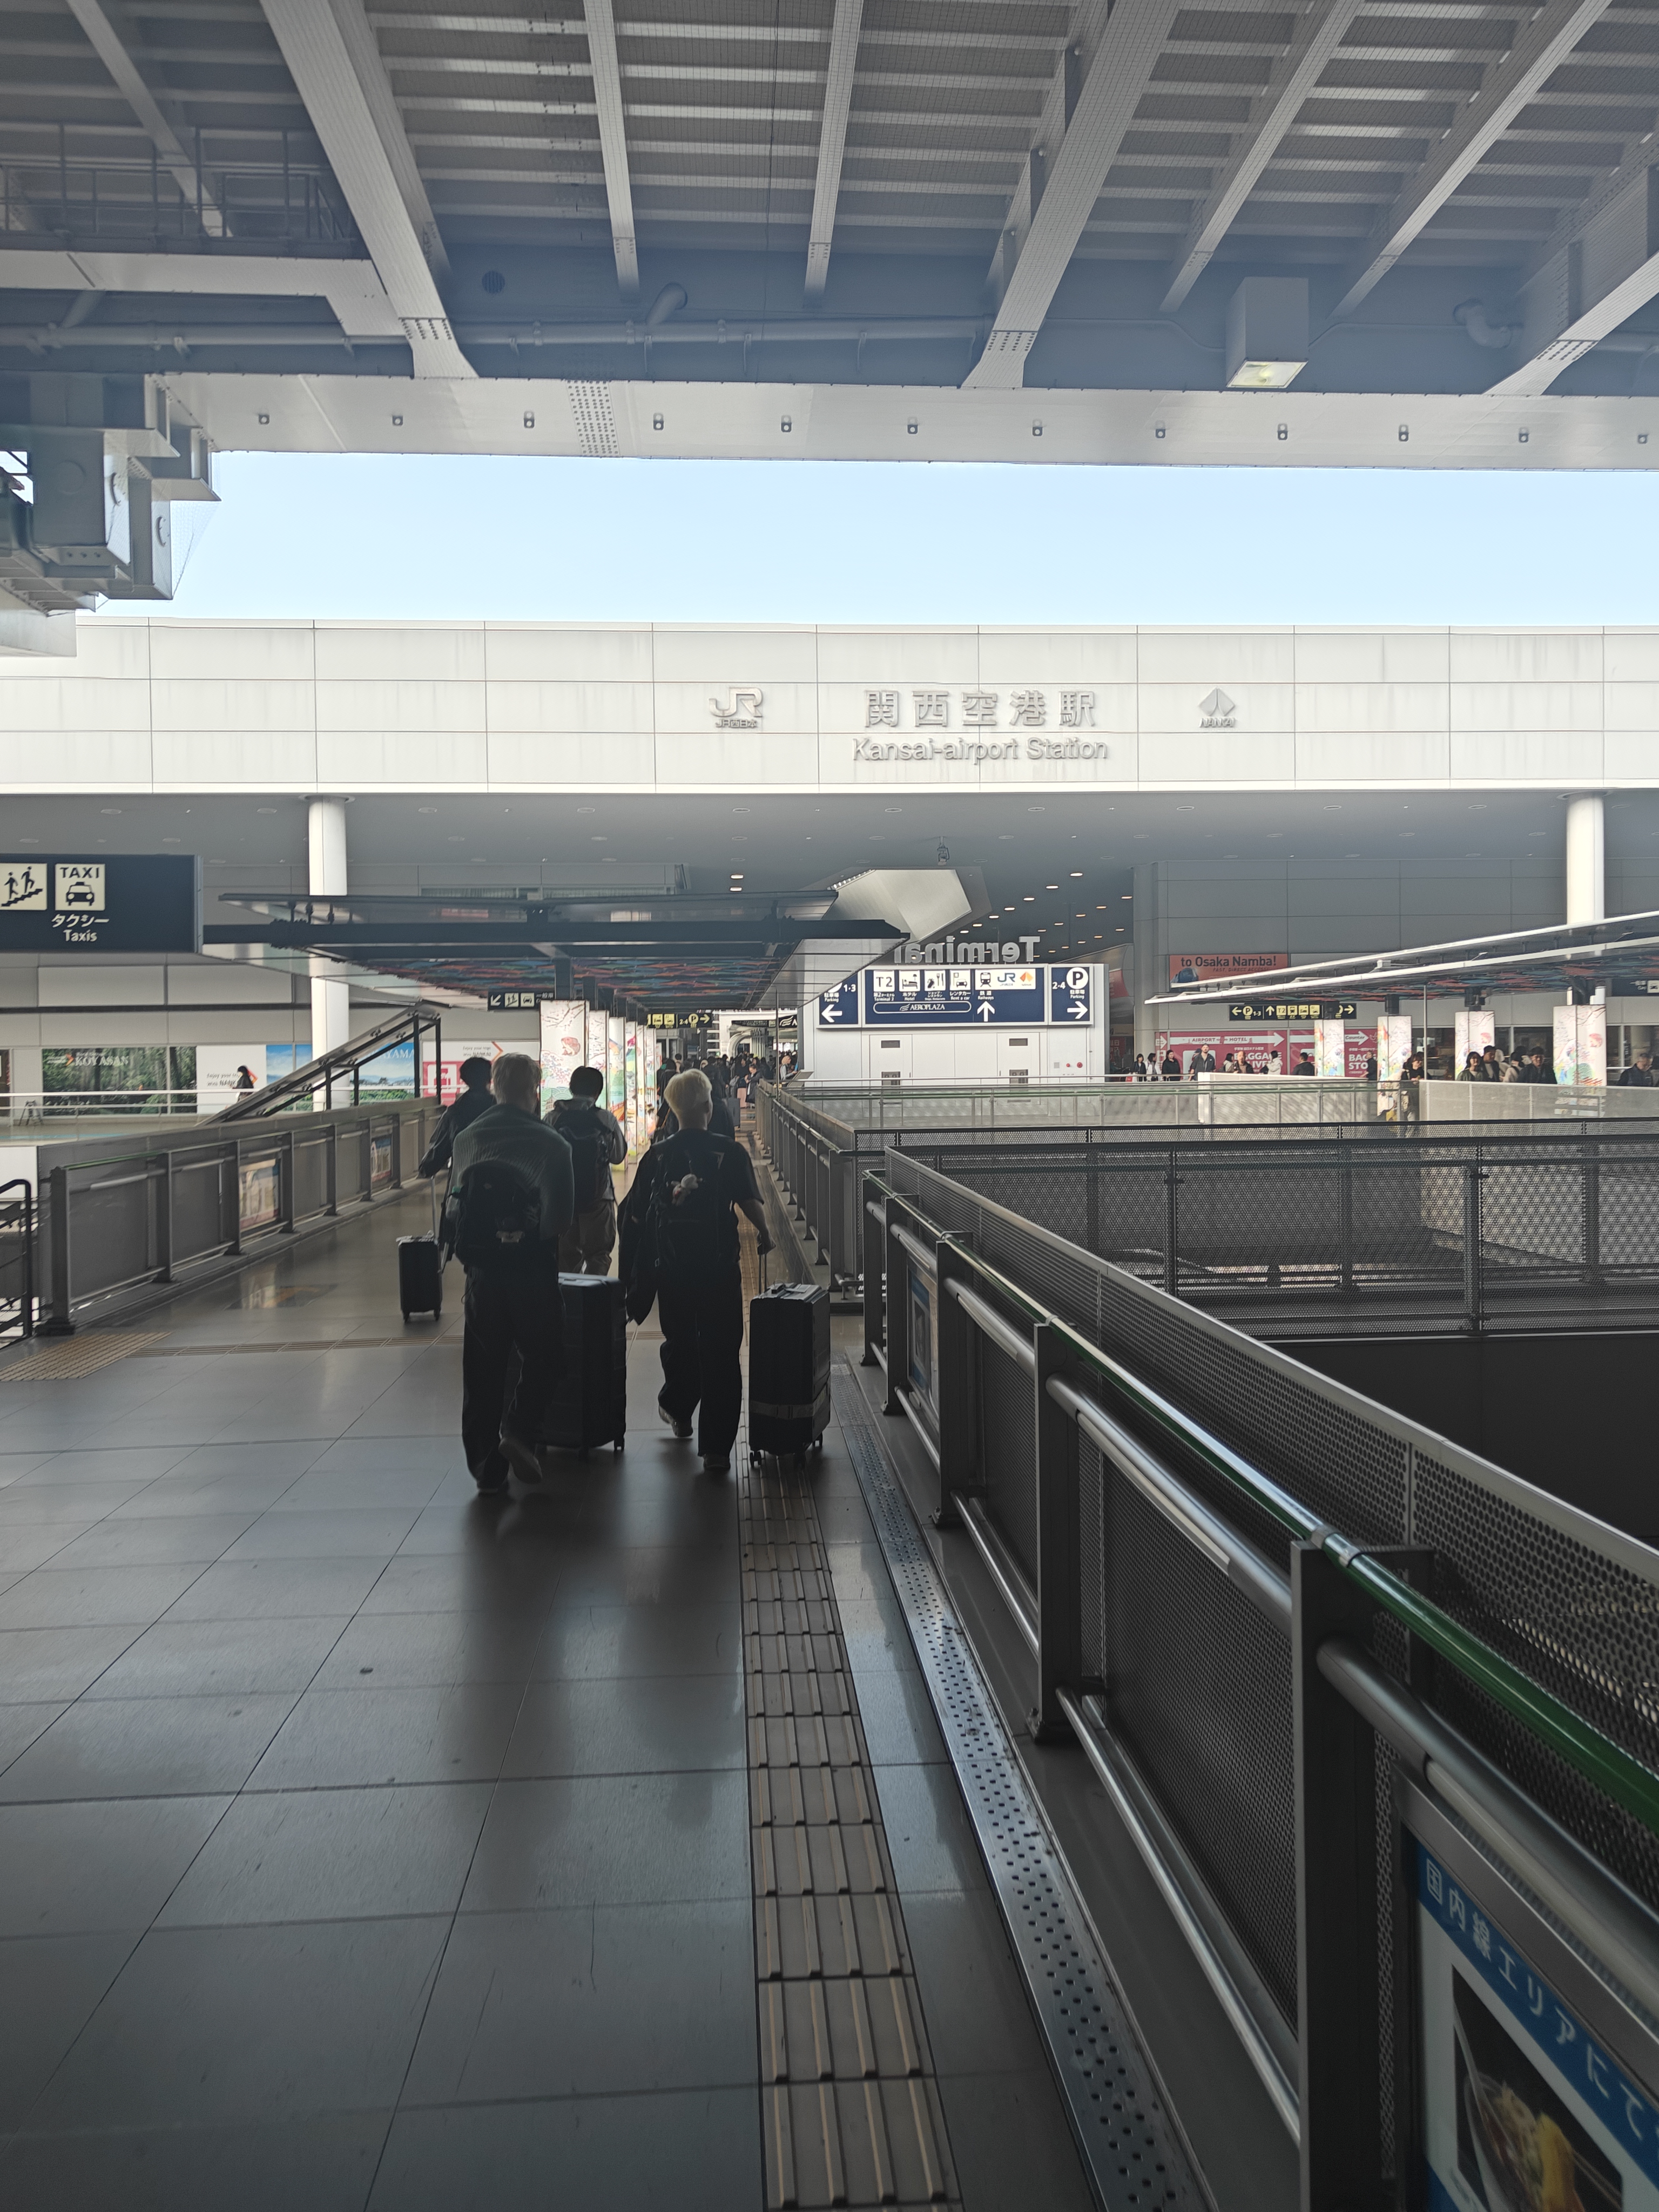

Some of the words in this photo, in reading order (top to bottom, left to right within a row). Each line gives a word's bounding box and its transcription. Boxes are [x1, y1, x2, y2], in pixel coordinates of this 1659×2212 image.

[708, 687, 763, 717] JR
[865, 690, 1096, 727] 関西空港駅
[715, 718, 758, 728] JR西日本
[853, 737, 1019, 765] Kansai-airport
[1026, 737, 1108, 760] Station
[59, 867, 99, 879] TAXI
[51, 914, 110, 928] タクシー
[63, 929, 98, 942] Taxis
[1181, 957, 1192, 967] to
[1195, 956, 1229, 967] Osaka
[1232, 955, 1277, 967] Namba!
[997, 973, 1015, 982] JR
[1073, 971, 1083, 986] P
[75, 1055, 129, 1066] KOYASAN
[1426, 1858, 1659, 2161] 国内線エリアにて
